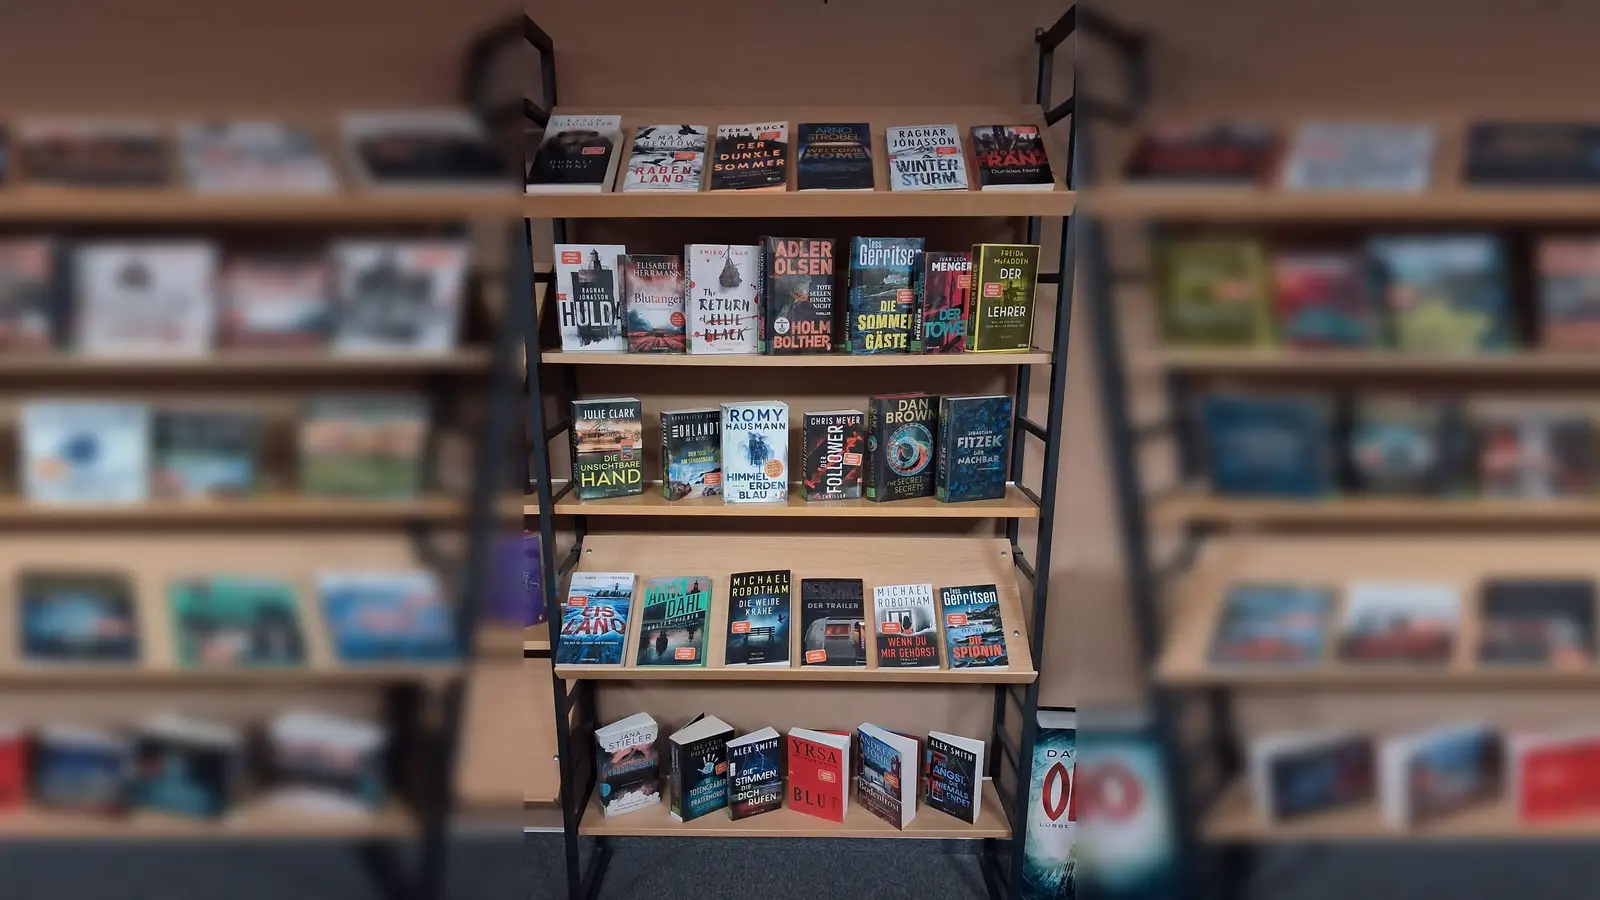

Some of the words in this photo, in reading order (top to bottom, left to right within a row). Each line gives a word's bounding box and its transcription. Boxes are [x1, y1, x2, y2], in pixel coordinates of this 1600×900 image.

[815, 126, 853, 134] ARNO
[898, 129, 947, 138] RAGNAR
[807, 133, 858, 141] STROBEL
[736, 141, 765, 150] DER
[719, 149, 781, 161] DUNKLE
[634, 166, 693, 175] RABEN
[714, 159, 785, 172] SOMMER
[895, 159, 959, 172] WINTER
[639, 174, 685, 183] LAND
[901, 172, 958, 185] STURM
[774, 240, 833, 258] ADLER
[868, 238, 882, 249] Tess
[859, 243, 922, 266] Gerritse
[1000, 249, 1024, 257] FREIDA
[636, 261, 678, 271] ELISABETH
[773, 258, 833, 275] OLSEN
[931, 261, 972, 272] MENGER
[633, 269, 682, 277] HERRMANN
[1000, 268, 1022, 280] DER
[703, 288, 717, 297] The
[634, 292, 684, 307] Blutanger
[698, 298, 750, 312] RETURN
[880, 300, 897, 312] DIE
[987, 306, 1026, 318] LEHRER
[710, 312, 743, 326] ELLIE
[939, 308, 961, 321] DER
[790, 320, 831, 335] HOLM
[923, 319, 968, 339] TOWE
[704, 327, 749, 341] BLACK
[865, 330, 908, 350] GÄSTE
[773, 335, 831, 349] BOLTHER
[898, 398, 929, 412] DAN
[583, 409, 606, 420] JULIE
[609, 408, 635, 419] CLARK
[730, 408, 784, 422] ROMY
[885, 408, 936, 424] BROWN
[725, 422, 786, 431] HAUSMANN
[810, 417, 833, 426] CHRIS
[836, 416, 861, 425] MEYER
[679, 421, 720, 438] OHLANDT
[957, 434, 1003, 449] FITZEK
[604, 454, 618, 462] DIE
[826, 425, 844, 494] FOLLOWER
[939, 446, 947, 480] FITZEK
[957, 455, 999, 465] NACHBAR
[580, 460, 641, 472] UNSICHTBARE
[581, 469, 641, 488] HAND
[726, 472, 769, 482] HIMMEL
[897, 476, 922, 485] SECRET
[749, 481, 786, 490] ERDEN
[894, 483, 924, 494] SECRETS
[739, 490, 768, 500] BLAU
[733, 574, 789, 587] MICHAEL
[732, 585, 789, 597] ROBOTHAM
[877, 585, 929, 597] MICHAEL
[738, 599, 752, 608] DIE
[878, 596, 930, 608] ROBOTHAM
[943, 591, 997, 606] Gerritsen
[580, 606, 616, 618] EIS
[667, 593, 703, 619] DAHL
[561, 617, 627, 635] LAND
[887, 637, 913, 647] WENN
[915, 636, 927, 646] DU
[968, 635, 983, 644] DIE
[881, 649, 896, 659] MIR
[952, 644, 1002, 660] SPIONIN
[608, 733, 652, 750] STIELER
[619, 730, 641, 741] JANA
[733, 746, 752, 757] ALEX
[755, 739, 778, 752] SMITH
[791, 739, 838, 765] YRSA
[930, 739, 948, 752] ALEX
[950, 745, 973, 762] SMITH
[741, 783, 752, 791] DIE
[935, 780, 969, 799] NIEMALS
[949, 780, 959, 789] DIE
[737, 788, 760, 801] DICH
[747, 792, 777, 807] RUFEN
[793, 786, 838, 813] BLUT
[859, 779, 900, 812] Bodenfrost
[946, 791, 971, 808] ENDET
